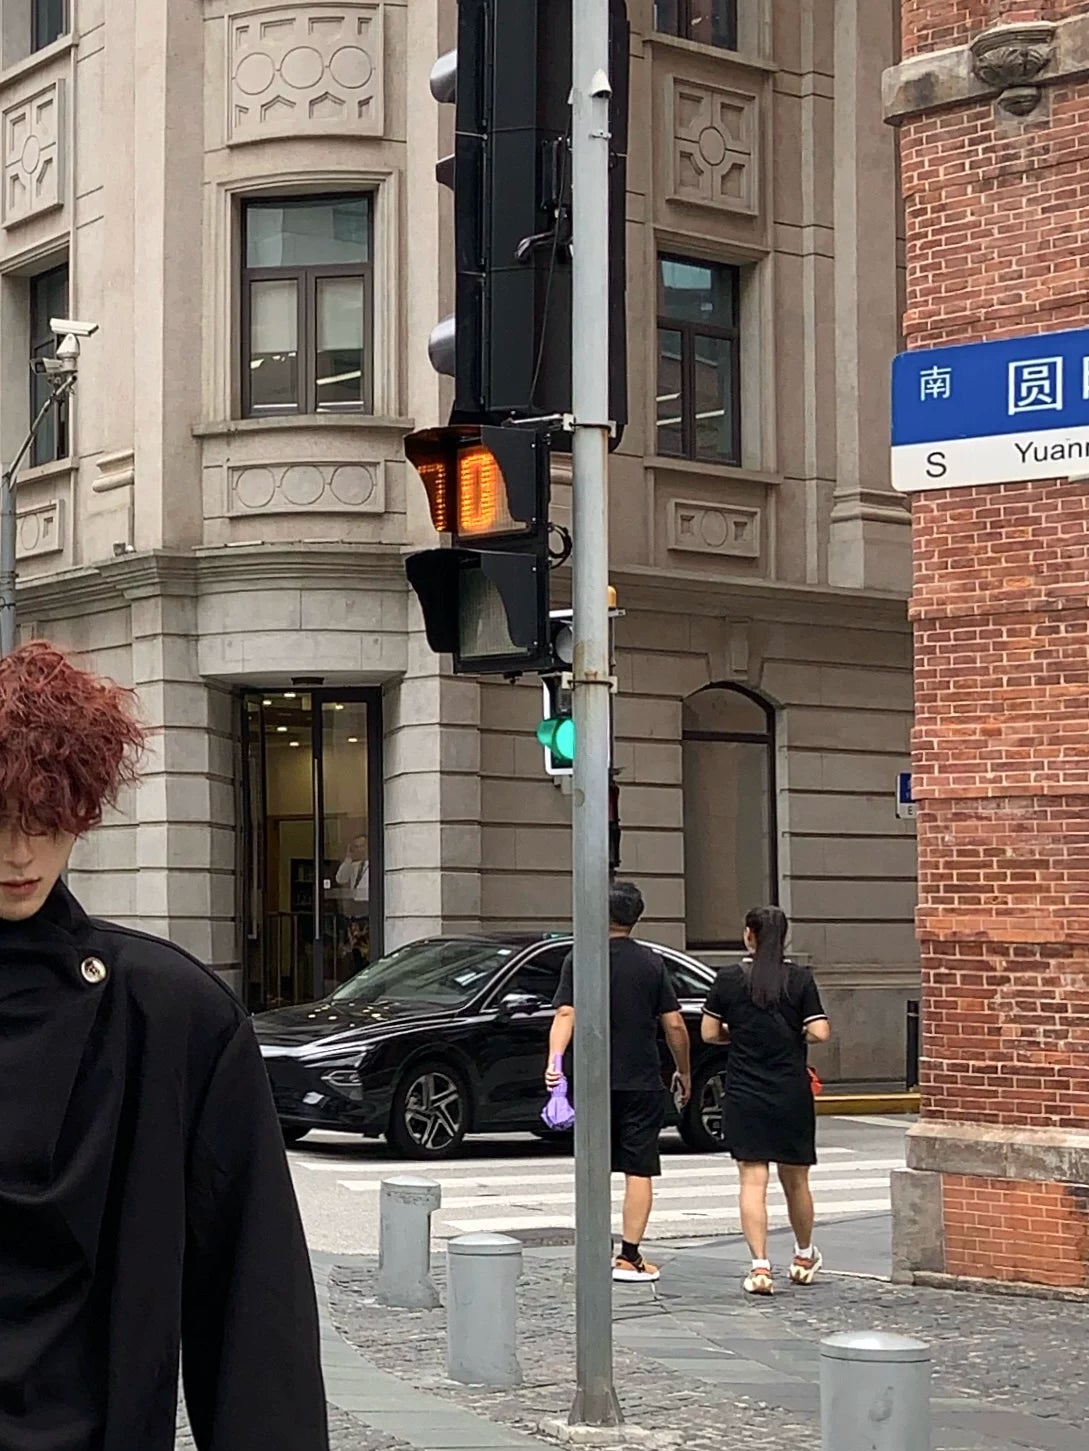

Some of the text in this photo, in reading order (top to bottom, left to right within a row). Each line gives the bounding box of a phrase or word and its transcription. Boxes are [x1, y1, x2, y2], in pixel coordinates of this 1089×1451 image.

[920, 356, 1089, 415] 南 圆
[926, 441, 1089, 478] S Yuan
